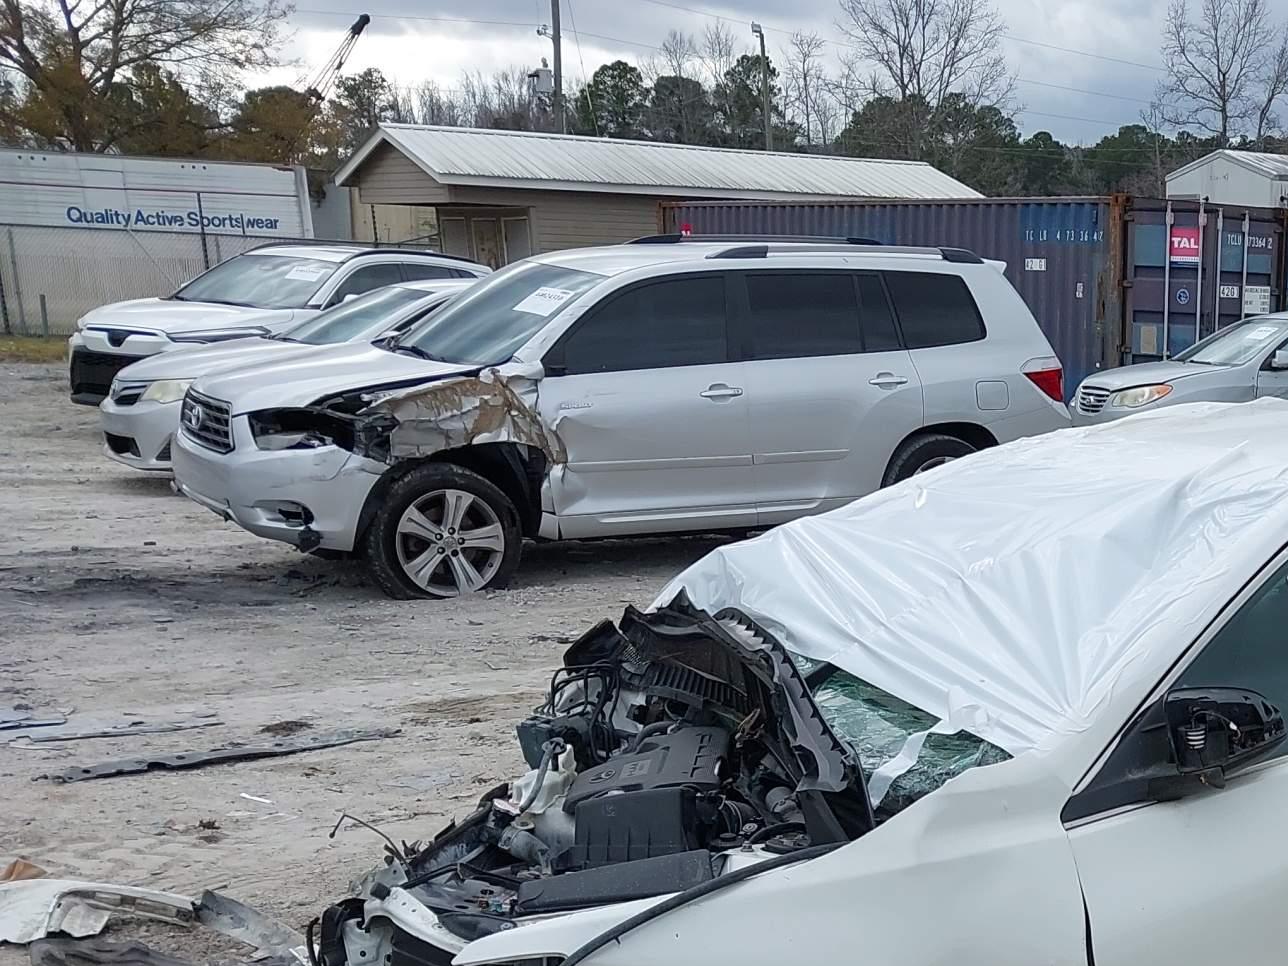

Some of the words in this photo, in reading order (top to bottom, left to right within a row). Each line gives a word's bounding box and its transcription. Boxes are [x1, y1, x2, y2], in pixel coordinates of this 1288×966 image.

[66, 206, 131, 228] Quality
[134, 209, 184, 227] Active
[187, 211, 279, 230] Sportswear
[1171, 237, 1199, 249] TAL
[1227, 233, 1242, 246] TCLU
[1247, 236, 1266, 249] 73364
